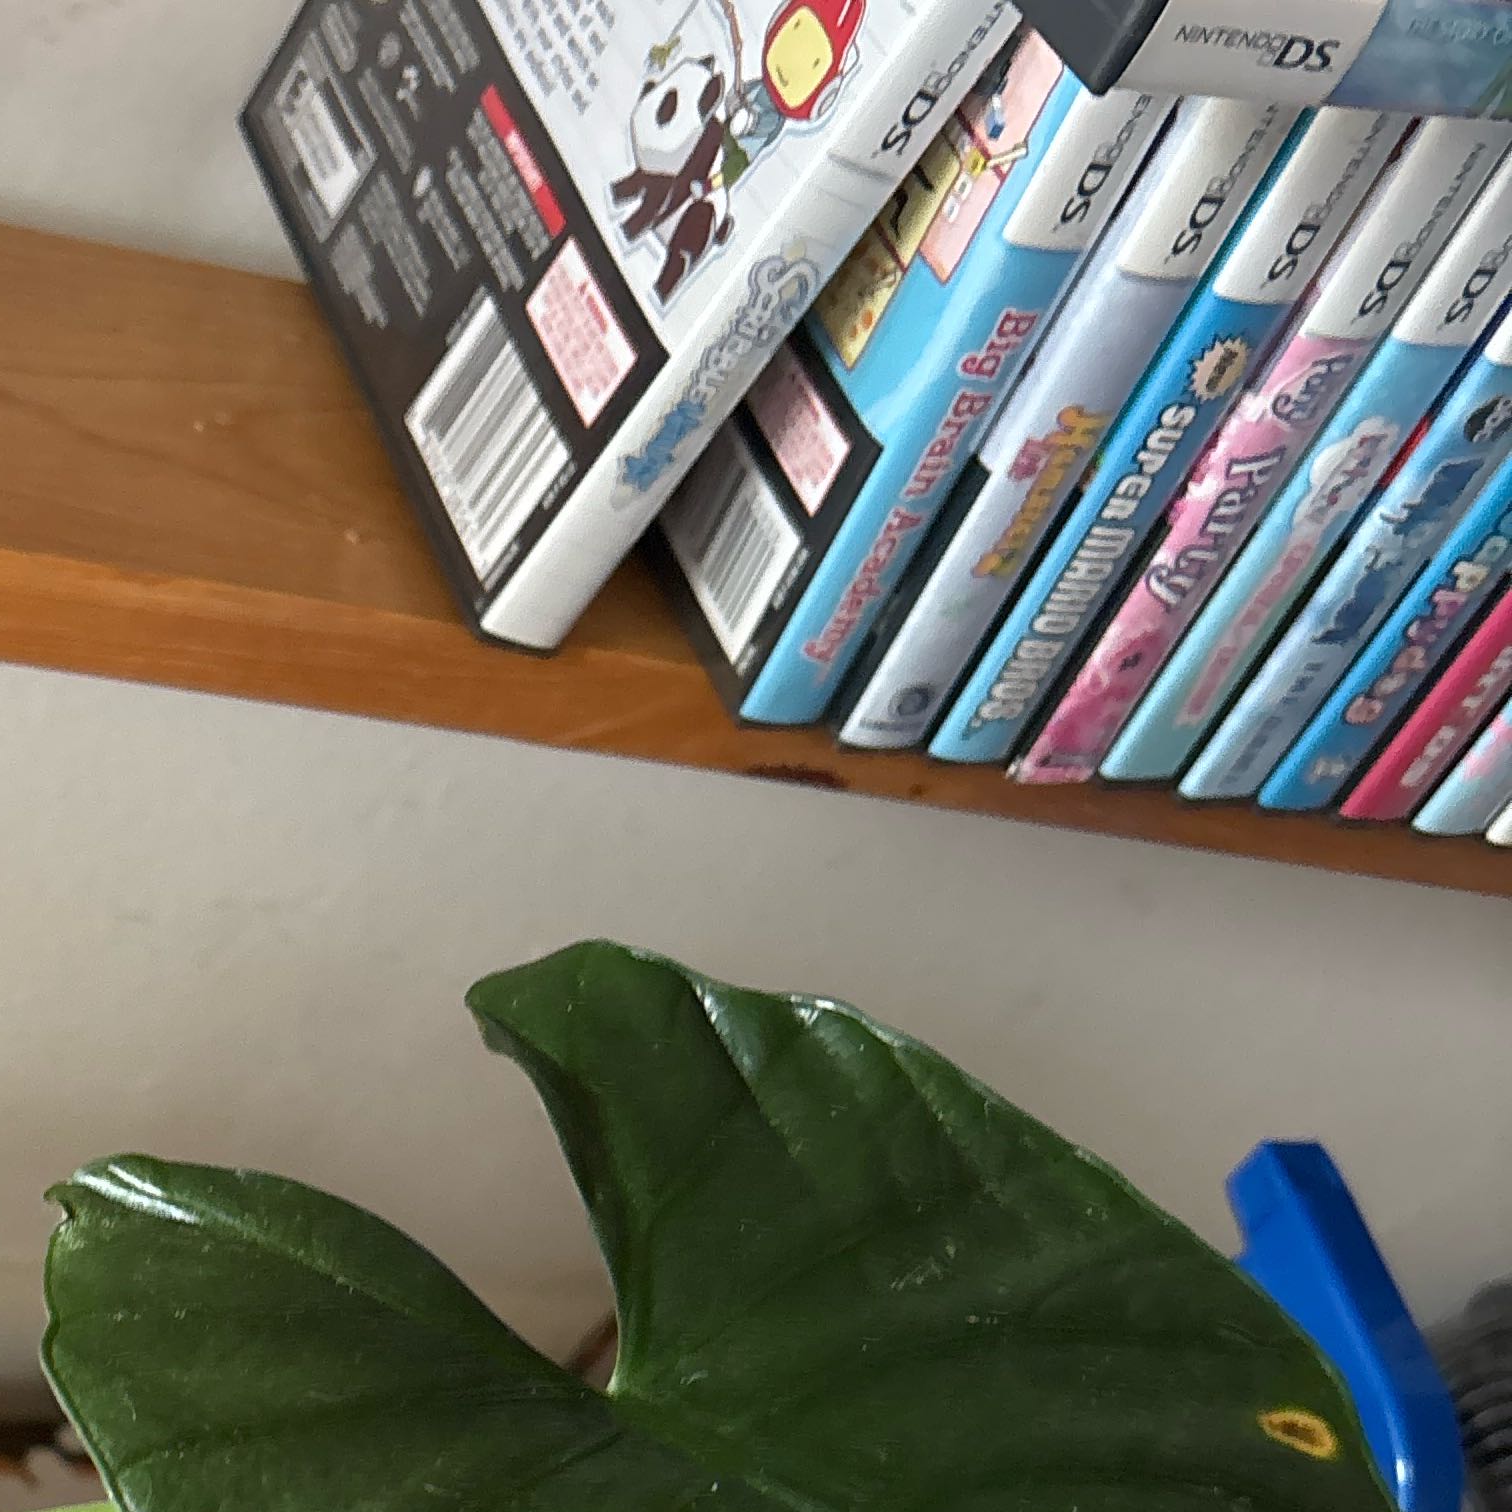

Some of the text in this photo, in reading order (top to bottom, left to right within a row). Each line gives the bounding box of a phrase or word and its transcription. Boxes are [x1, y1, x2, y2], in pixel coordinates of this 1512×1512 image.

[1175, 24, 1341, 72] NINTENDO DS
[880, 88, 939, 156] DS
[1059, 161, 1113, 225] DS
[1171, 192, 1228, 257] DS
[1267, 222, 1322, 283] DS
[1357, 258, 1414, 318] DS
[1443, 267, 1499, 327] DS
[961, 309, 1040, 378] Big
[901, 391, 993, 498] Brain
[1101, 403, 1197, 521] SUPER
[1145, 446, 1287, 614] Party
[803, 508, 923, 663] Academy
[1032, 526, 1136, 636] MARIO
